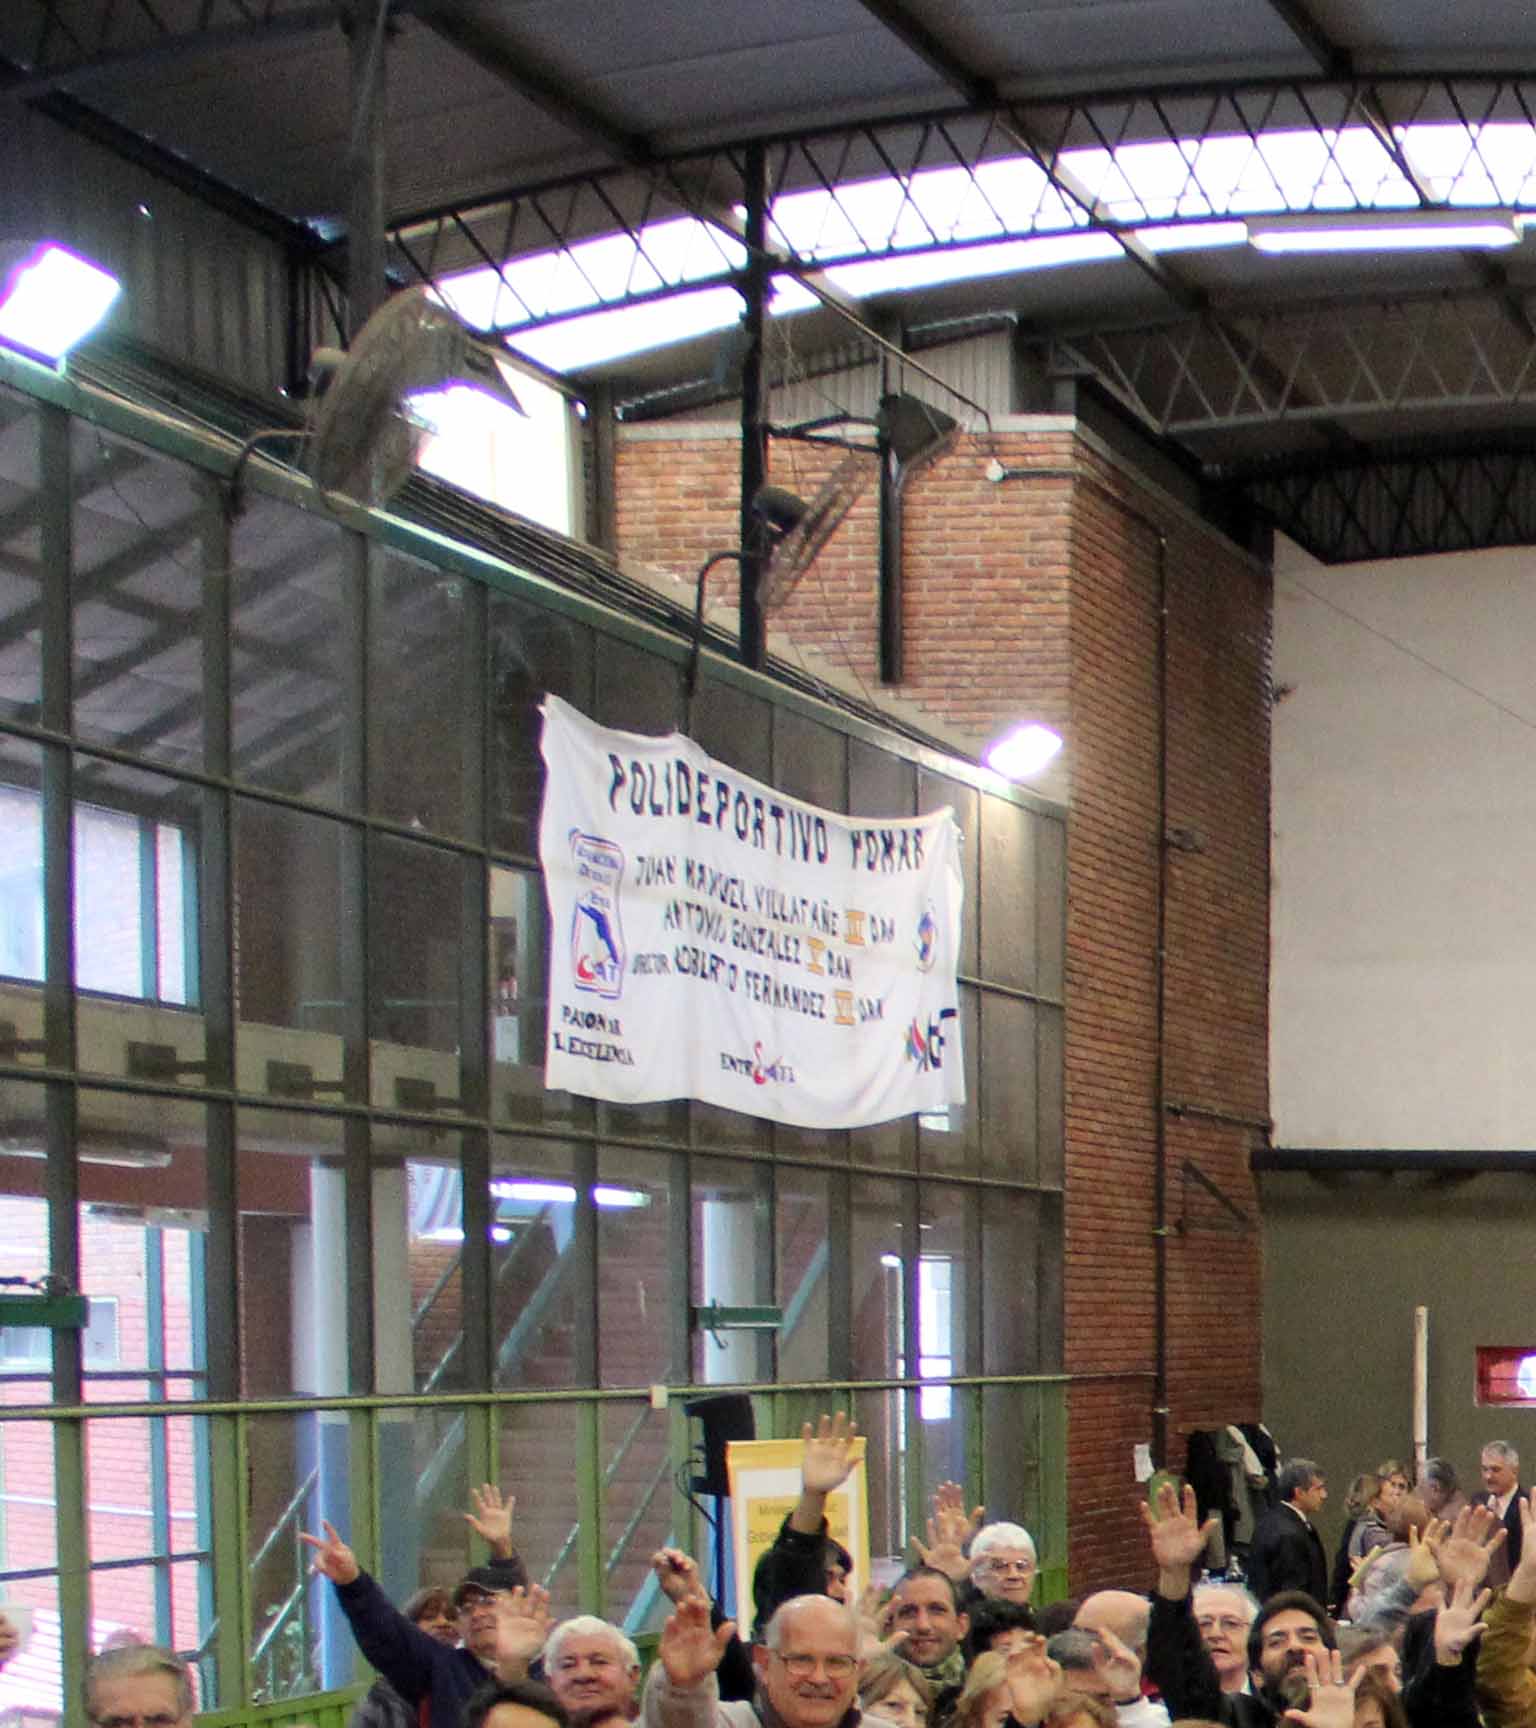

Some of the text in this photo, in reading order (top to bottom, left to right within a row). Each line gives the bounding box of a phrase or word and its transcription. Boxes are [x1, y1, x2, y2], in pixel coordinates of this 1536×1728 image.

[608, 753, 925, 873] POLIDEPORTIVO POMAR
[634, 855, 676, 887] JUAN
[685, 857, 749, 912] MANUEL
[732, 917, 802, 965] GONZALEZ
[744, 968, 827, 1020] FERNANDEZ
